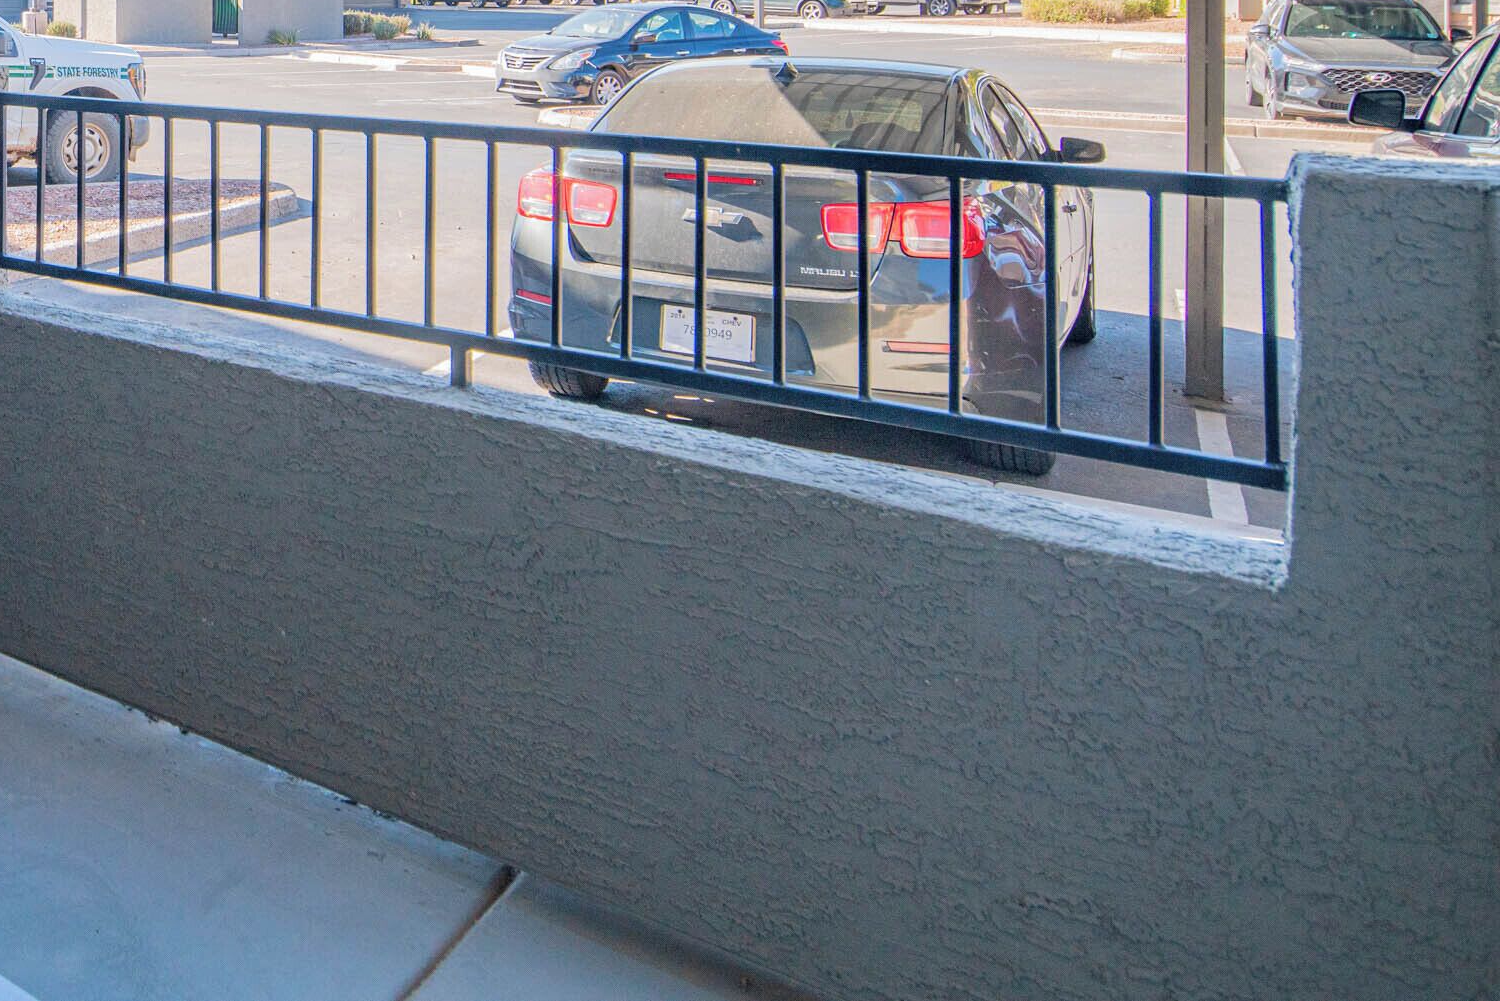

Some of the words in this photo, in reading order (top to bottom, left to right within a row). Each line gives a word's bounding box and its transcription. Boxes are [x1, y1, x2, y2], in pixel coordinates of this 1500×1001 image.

[57, 65, 81, 78] STATE
[82, 66, 119, 79] FORESTRY
[799, 265, 846, 277] MALIBU
[683, 323, 733, 341] 780949
